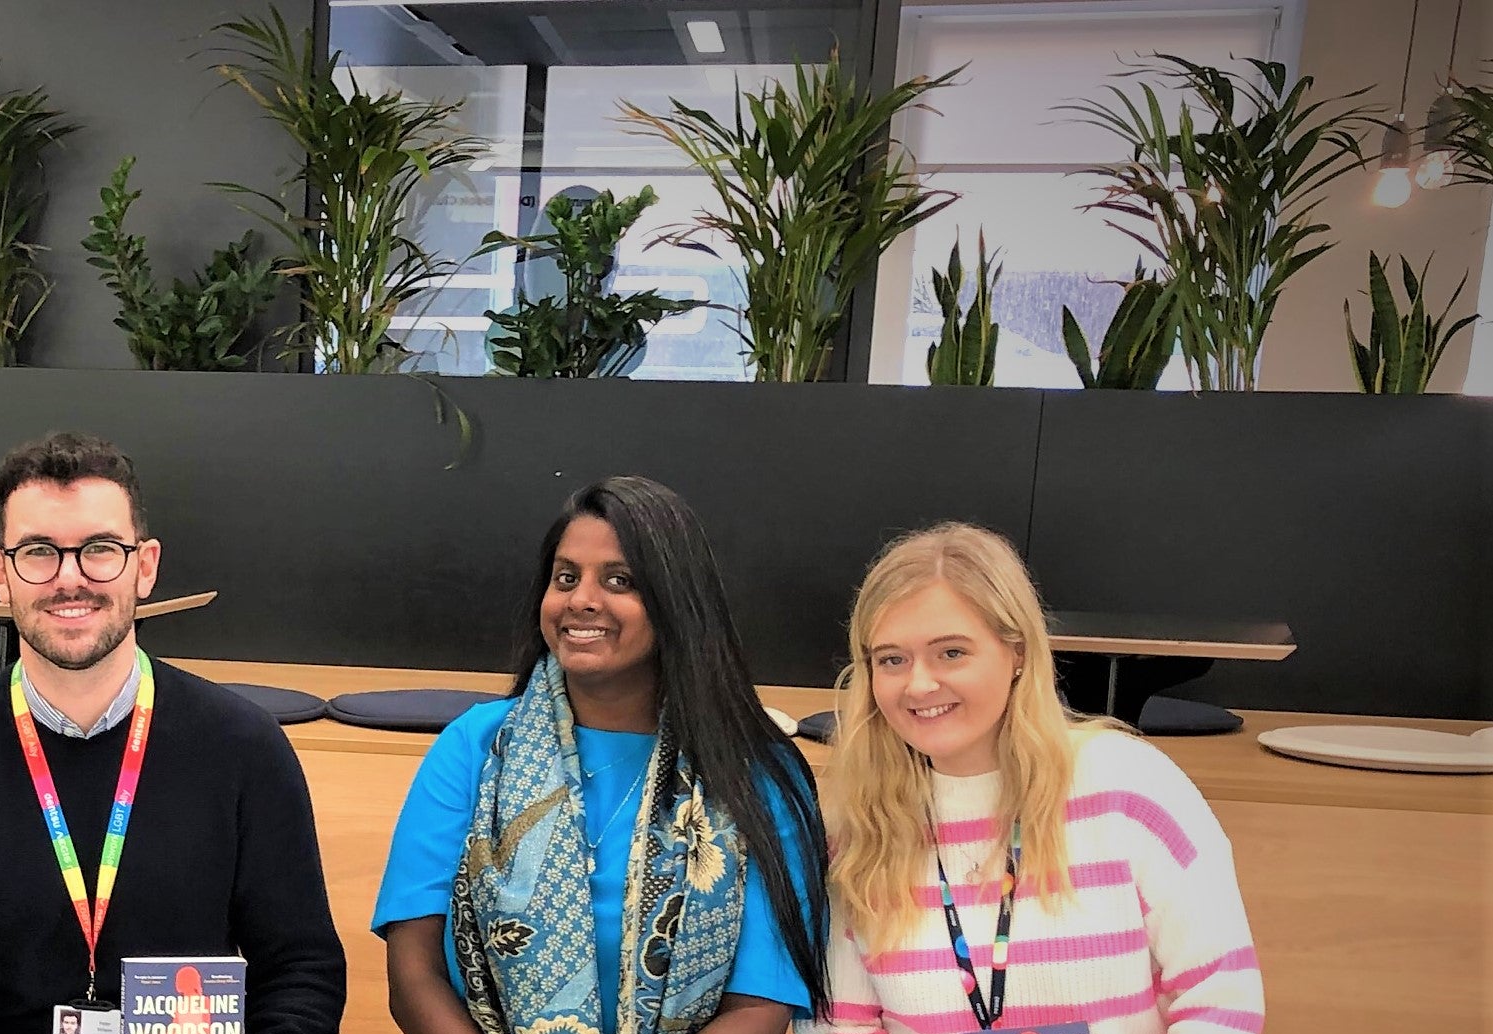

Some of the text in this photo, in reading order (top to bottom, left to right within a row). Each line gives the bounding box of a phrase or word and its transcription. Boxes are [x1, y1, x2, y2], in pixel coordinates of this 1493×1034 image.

[131, 715, 147, 752] dentsu
[43, 793, 61, 829] dentsu
[112, 808, 125, 833] LGBT
[132, 994, 240, 1018] JACQUELINE
